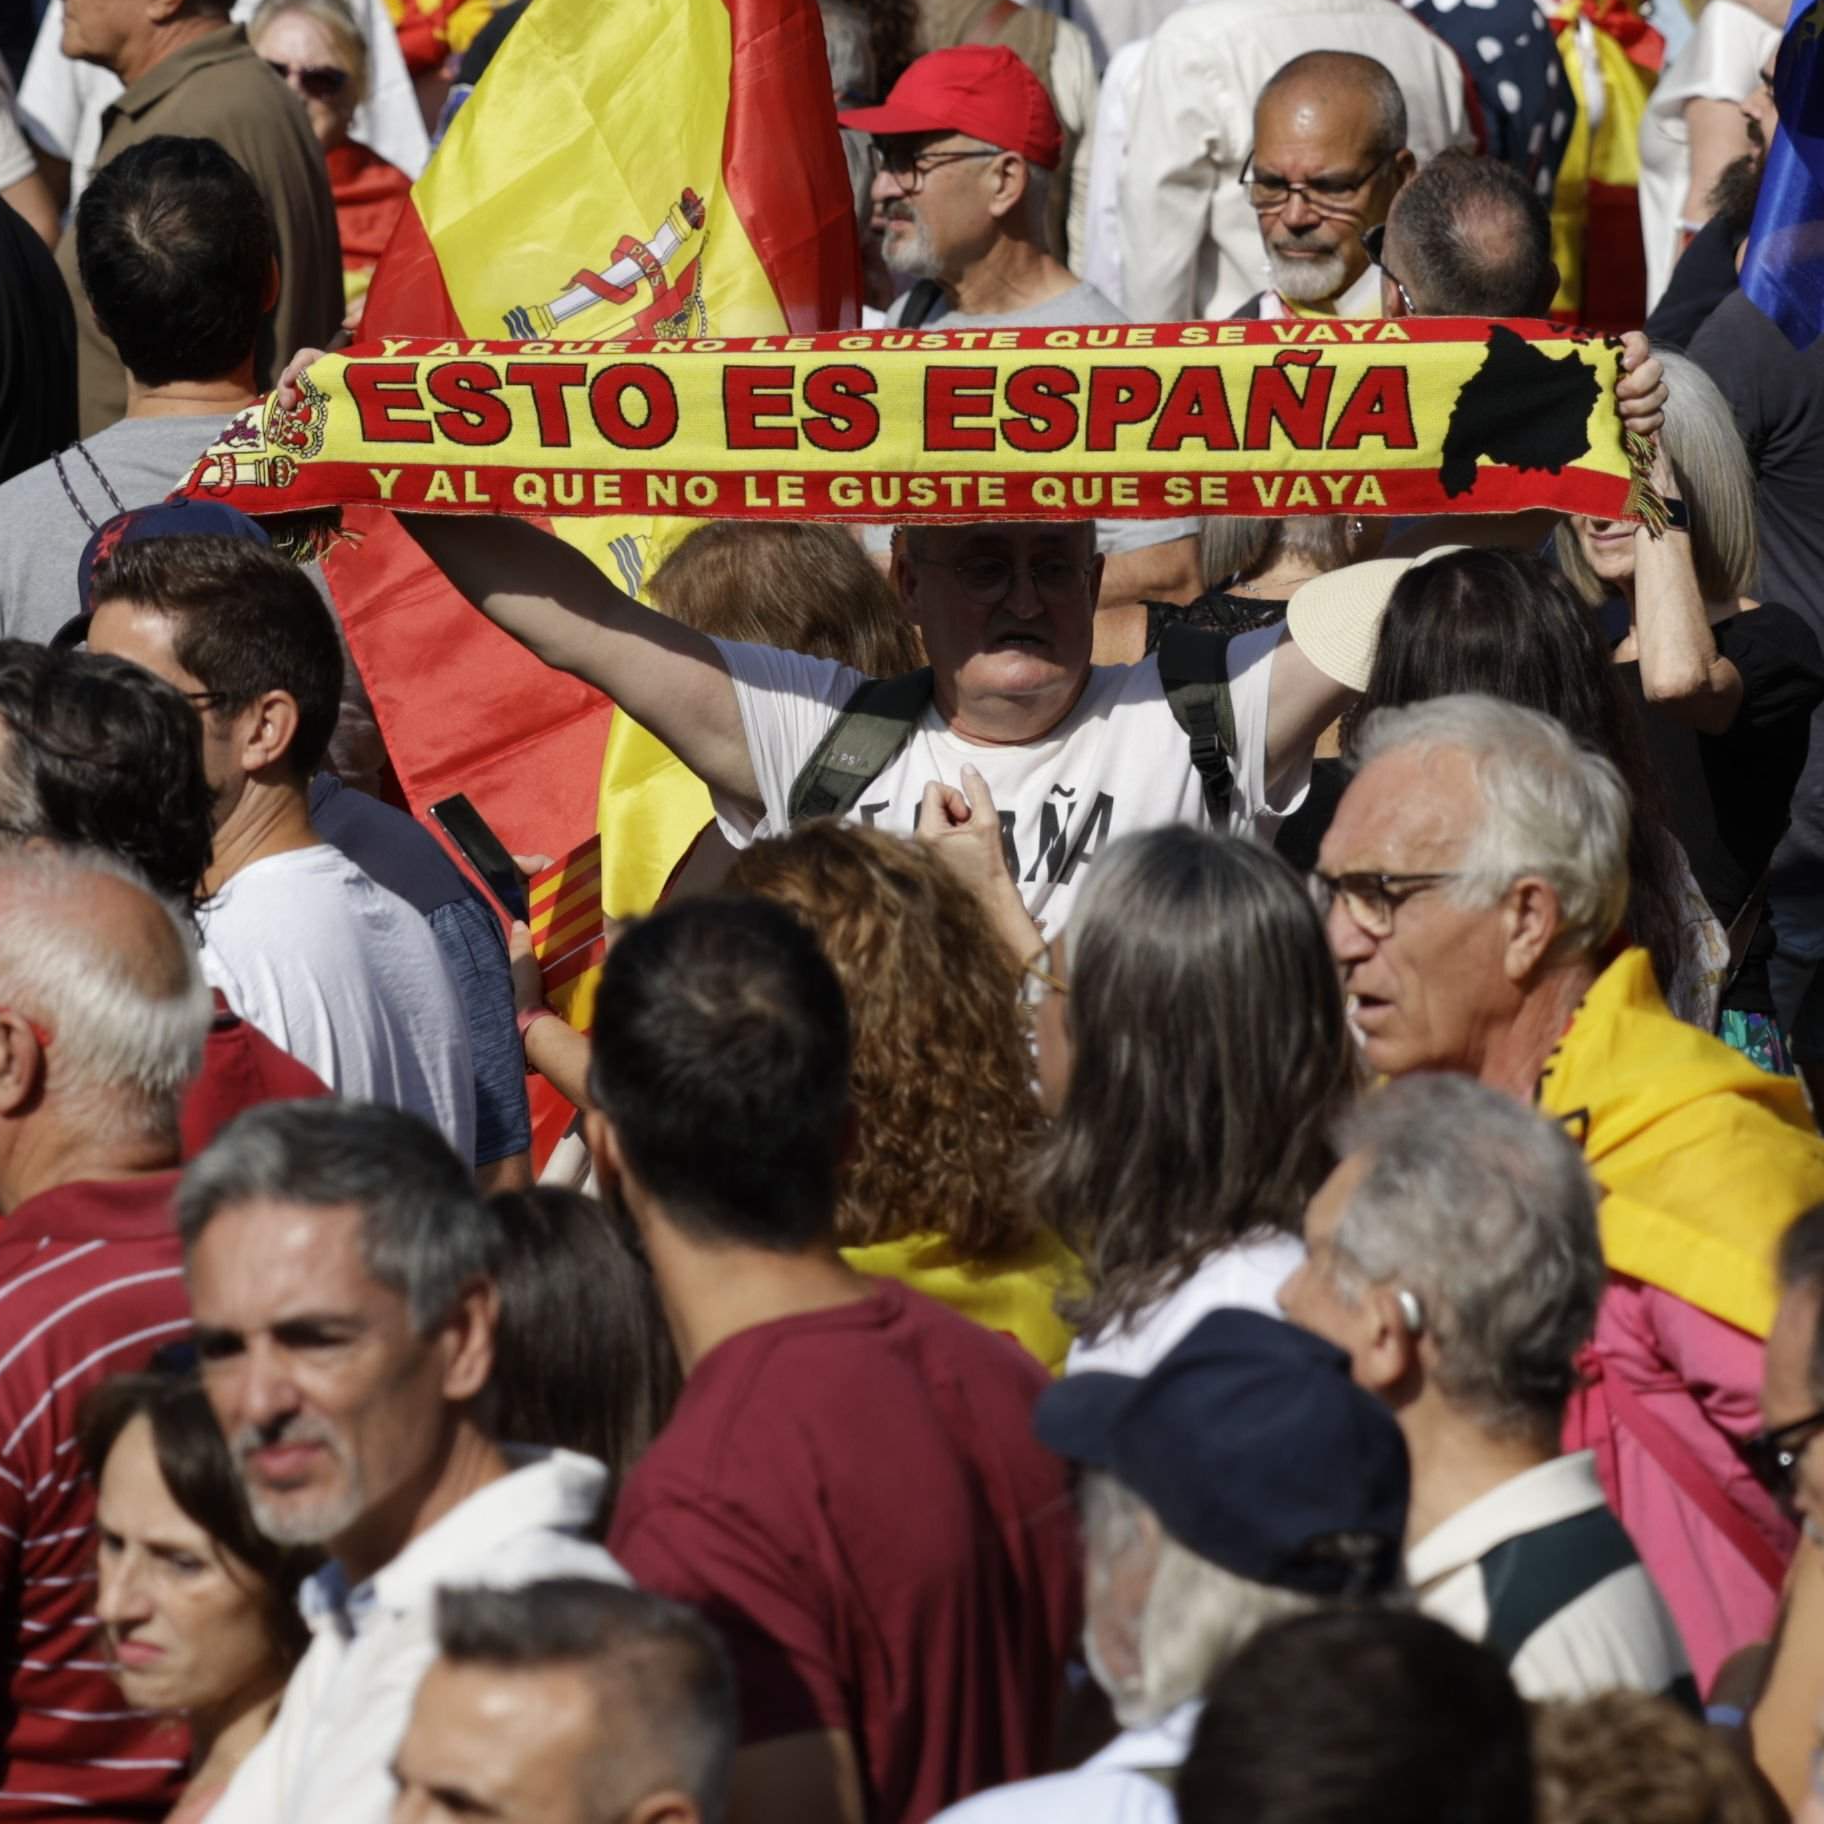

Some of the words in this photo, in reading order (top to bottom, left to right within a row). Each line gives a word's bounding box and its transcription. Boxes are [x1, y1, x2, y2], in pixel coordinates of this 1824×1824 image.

[629, 244, 663, 287] PLVS
[382, 340, 414, 357] Y
[436, 340, 493, 357] AL
[517, 340, 632, 355] QUE
[651, 339, 728, 353] NO
[751, 337, 816, 352] LE
[838, 332, 1021, 350] GUSTE
[1044, 328, 1155, 348] QUE
[1178, 325, 1246, 345] SE
[1271, 323, 1411, 343] VAYA
[344, 362, 679, 450] ESTO
[722, 364, 880, 452] ES
[923, 349, 1418, 452] ESPAÑA
[369, 469, 402, 499] Y
[425, 470, 491, 503] AL
[513, 473, 622, 507] QUE
[646, 475, 719, 507] NO
[744, 476, 805, 507] LE
[828, 476, 1006, 507] GUSTE
[1031, 476, 1140, 510] QUE
[1162, 476, 1229, 506] SE
[1252, 475, 1388, 507] VAYA
